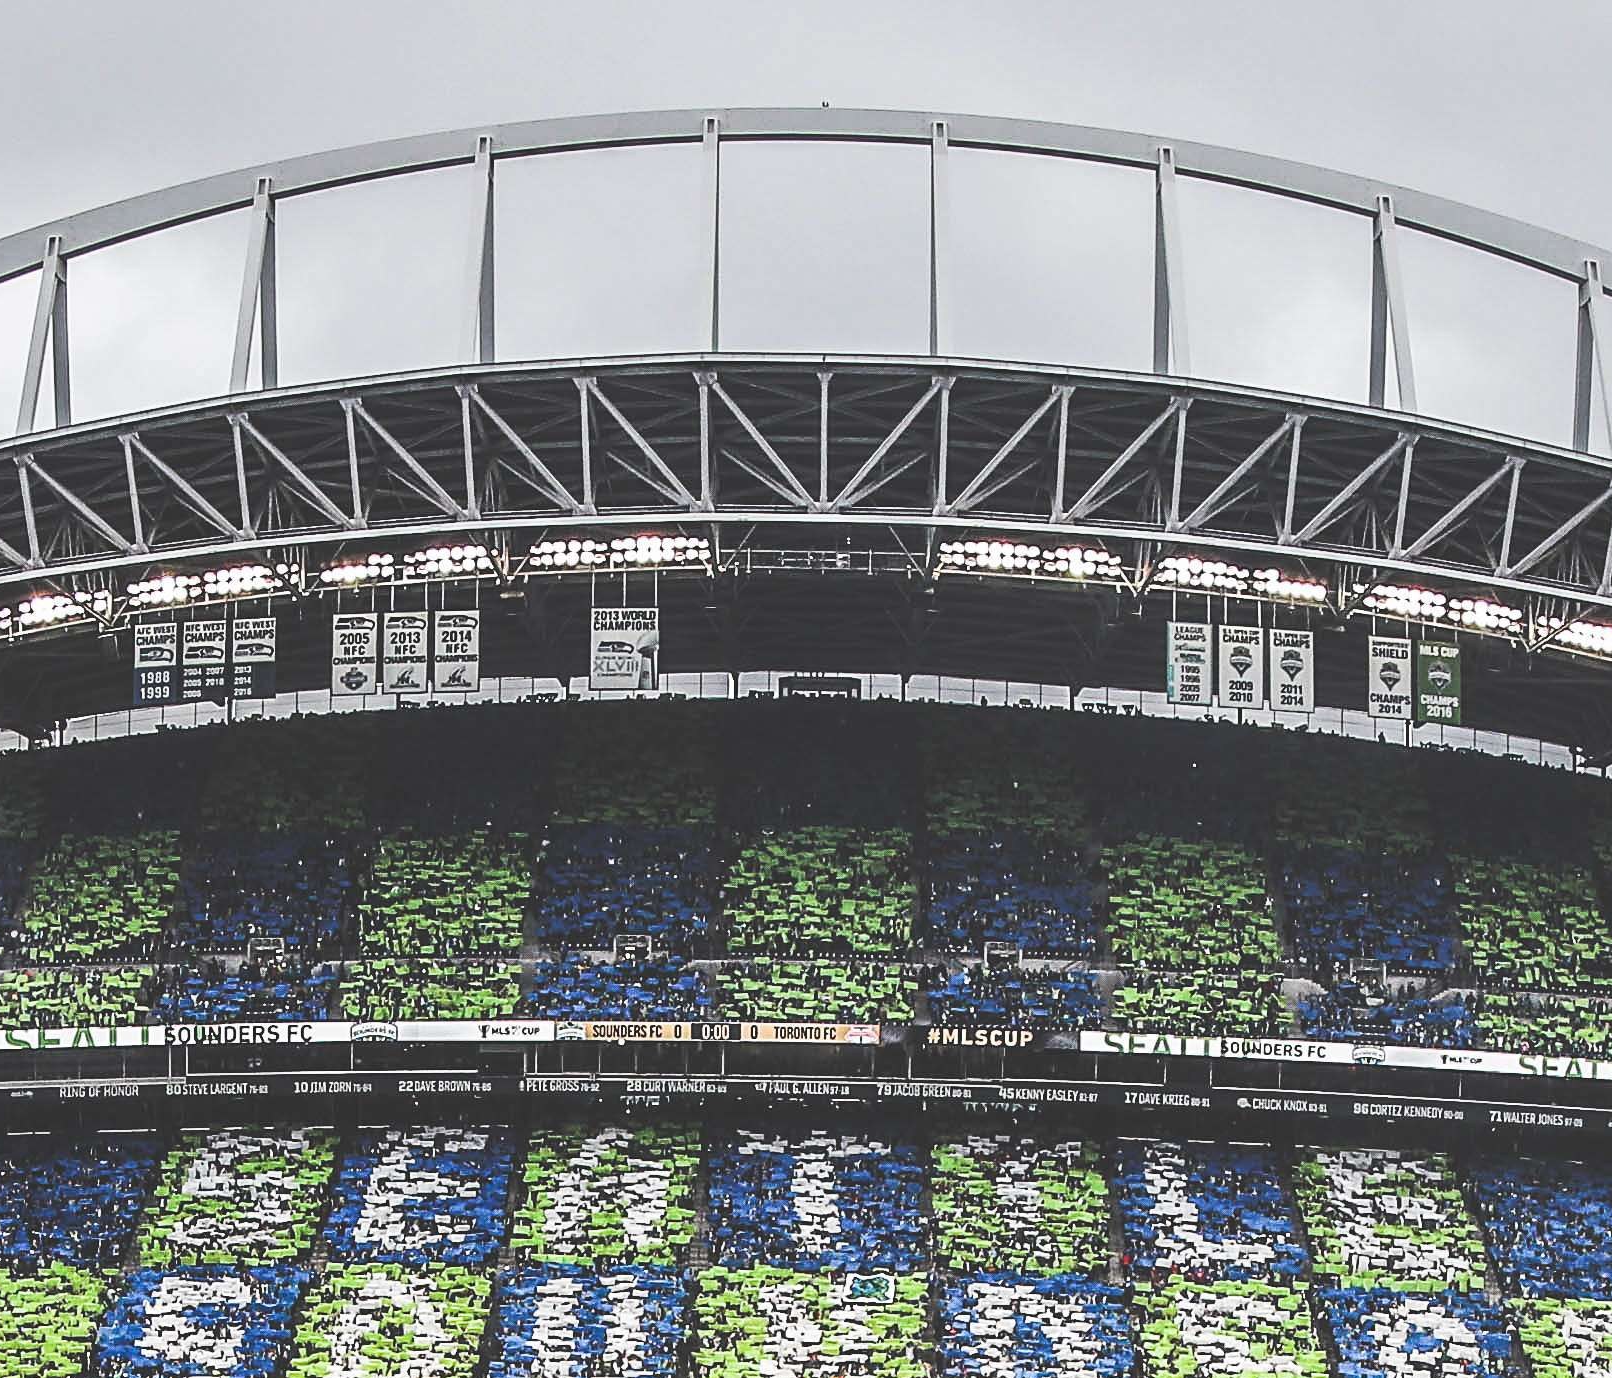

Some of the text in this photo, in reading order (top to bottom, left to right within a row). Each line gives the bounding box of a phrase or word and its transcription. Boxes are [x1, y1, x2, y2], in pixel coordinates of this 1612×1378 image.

[594, 610, 656, 620] 2013 WORLD
[203, 622, 225, 631] WEST
[252, 620, 275, 629] WEST
[593, 620, 656, 631] CHAMPIONS
[136, 634, 176, 646] CHAMPS
[185, 632, 225, 643] CHAMPS
[234, 629, 275, 640] CHAMPS
[339, 633, 370, 645] 2005
[390, 631, 421, 644] 2013
[441, 630, 472, 643] 2014
[1174, 633, 1206, 642] CHAMPS
[1222, 635, 1260, 645] CHAMPS
[445, 643, 468, 653] NFC
[1273, 638, 1310, 649] CHAMPS
[343, 646, 366, 656] NFC
[394, 645, 417, 655] NFC
[1372, 647, 1408, 659] SHIELD
[1419, 644, 1460, 658] MLS CUP
[593, 660, 639, 672] XLVIII
[141, 671, 170, 685] 1988
[1229, 681, 1254, 691] 2009
[1280, 684, 1303, 695] 2011
[141, 686, 170, 700] 1999
[1229, 692, 1253, 702] 2010
[1370, 693, 1411, 705] CHAMPS
[1280, 695, 1304, 706] 2014
[1420, 694, 1460, 708] CHAMPS
[1378, 704, 1402, 714] 2014
[1426, 705, 1453, 718] 2016
[164, 1024, 313, 1046] SOUNDERS FC
[491, 1027, 541, 1036] MLS CUP
[593, 1024, 682, 1038] SOUNDERS FC 0
[701, 1023, 730, 1040] 0:00
[750, 1024, 837, 1040] 0 TORONTO FC
[926, 1027, 1035, 1048] #MLSCUP
[1220, 1039, 1327, 1059] SOUNDERS FC
[59, 1084, 139, 1098] RING OF HONOR
[166, 1083, 248, 1096] 80 STEVE LARGENT
[294, 1081, 352, 1093] 10 JIM ZORN
[398, 1080, 471, 1092] 22 DAVE BROWN
[526, 1080, 580, 1092] PETE GROSS
[626, 1080, 705, 1093] 28 CURT WARNER
[802, 1082, 830, 1095] ALLEN
[876, 1084, 951, 1097] 79 JACOB GREEN
[998, 1088, 1080, 1102] 45 KENNY EASLEY
[1124, 1091, 1191, 1106] 17 DAVE KRIEG
[1252, 1098, 1308, 1112] CHUCK KNOX
[1353, 1103, 1444, 1119] 96 CORTEZ KENNEDY
[1489, 1110, 1564, 1127] 71 WALTER JONES
